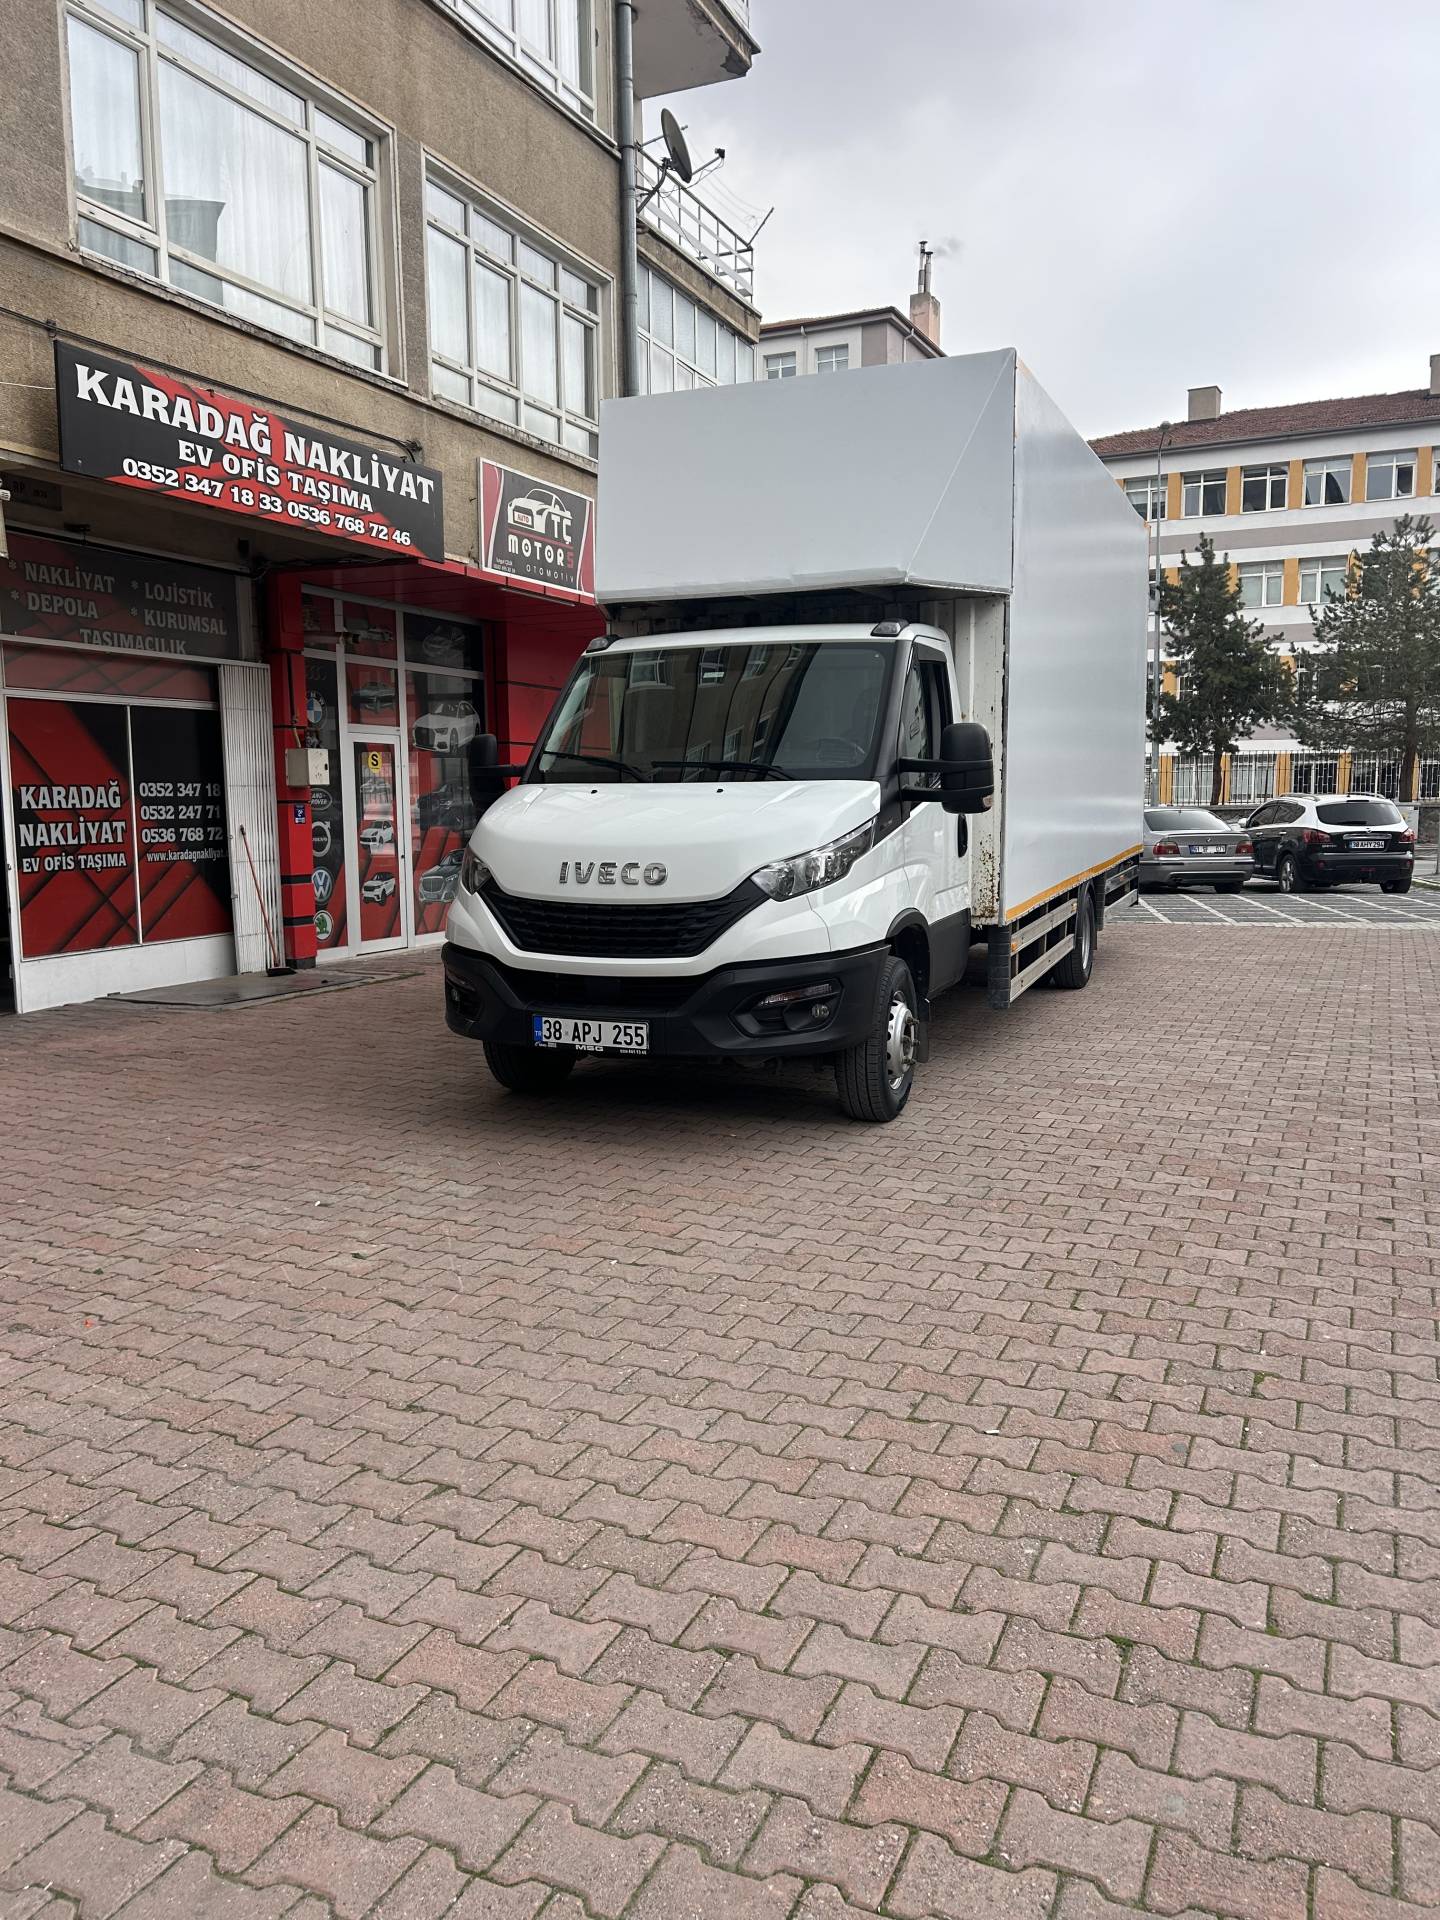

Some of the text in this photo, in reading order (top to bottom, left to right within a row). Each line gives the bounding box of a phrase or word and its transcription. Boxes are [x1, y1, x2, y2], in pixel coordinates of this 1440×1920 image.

[75, 363, 434, 505] KARADAĞ NAKLİYAT
[178, 439, 374, 513] EV OFİS TAŞIMA
[122, 457, 412, 546] 0352 347 18 33 0536 768 72 46
[551, 513, 572, 545] TÇ
[24, 561, 115, 594] NAKLİYAT
[27, 591, 99, 619] DEPOLA
[144, 581, 215, 609] LOJİSTİK
[143, 608, 228, 636] KURUMSAL
[20, 780, 121, 809] KARADAĞ
[139, 782, 221, 797] 0352 347 18
[140, 805, 221, 820] 0532 247 71
[19, 816, 126, 847] NAKLİYAT
[141, 827, 224, 843] 0536 768 72
[22, 852, 127, 873] EV OFİS TAŞIMA
[558, 861, 669, 886] IVECO
[543, 1019, 562, 1040] 38
[571, 1021, 602, 1044] APJ
[612, 1024, 645, 1047] 255
[575, 1044, 604, 1052] MSG
